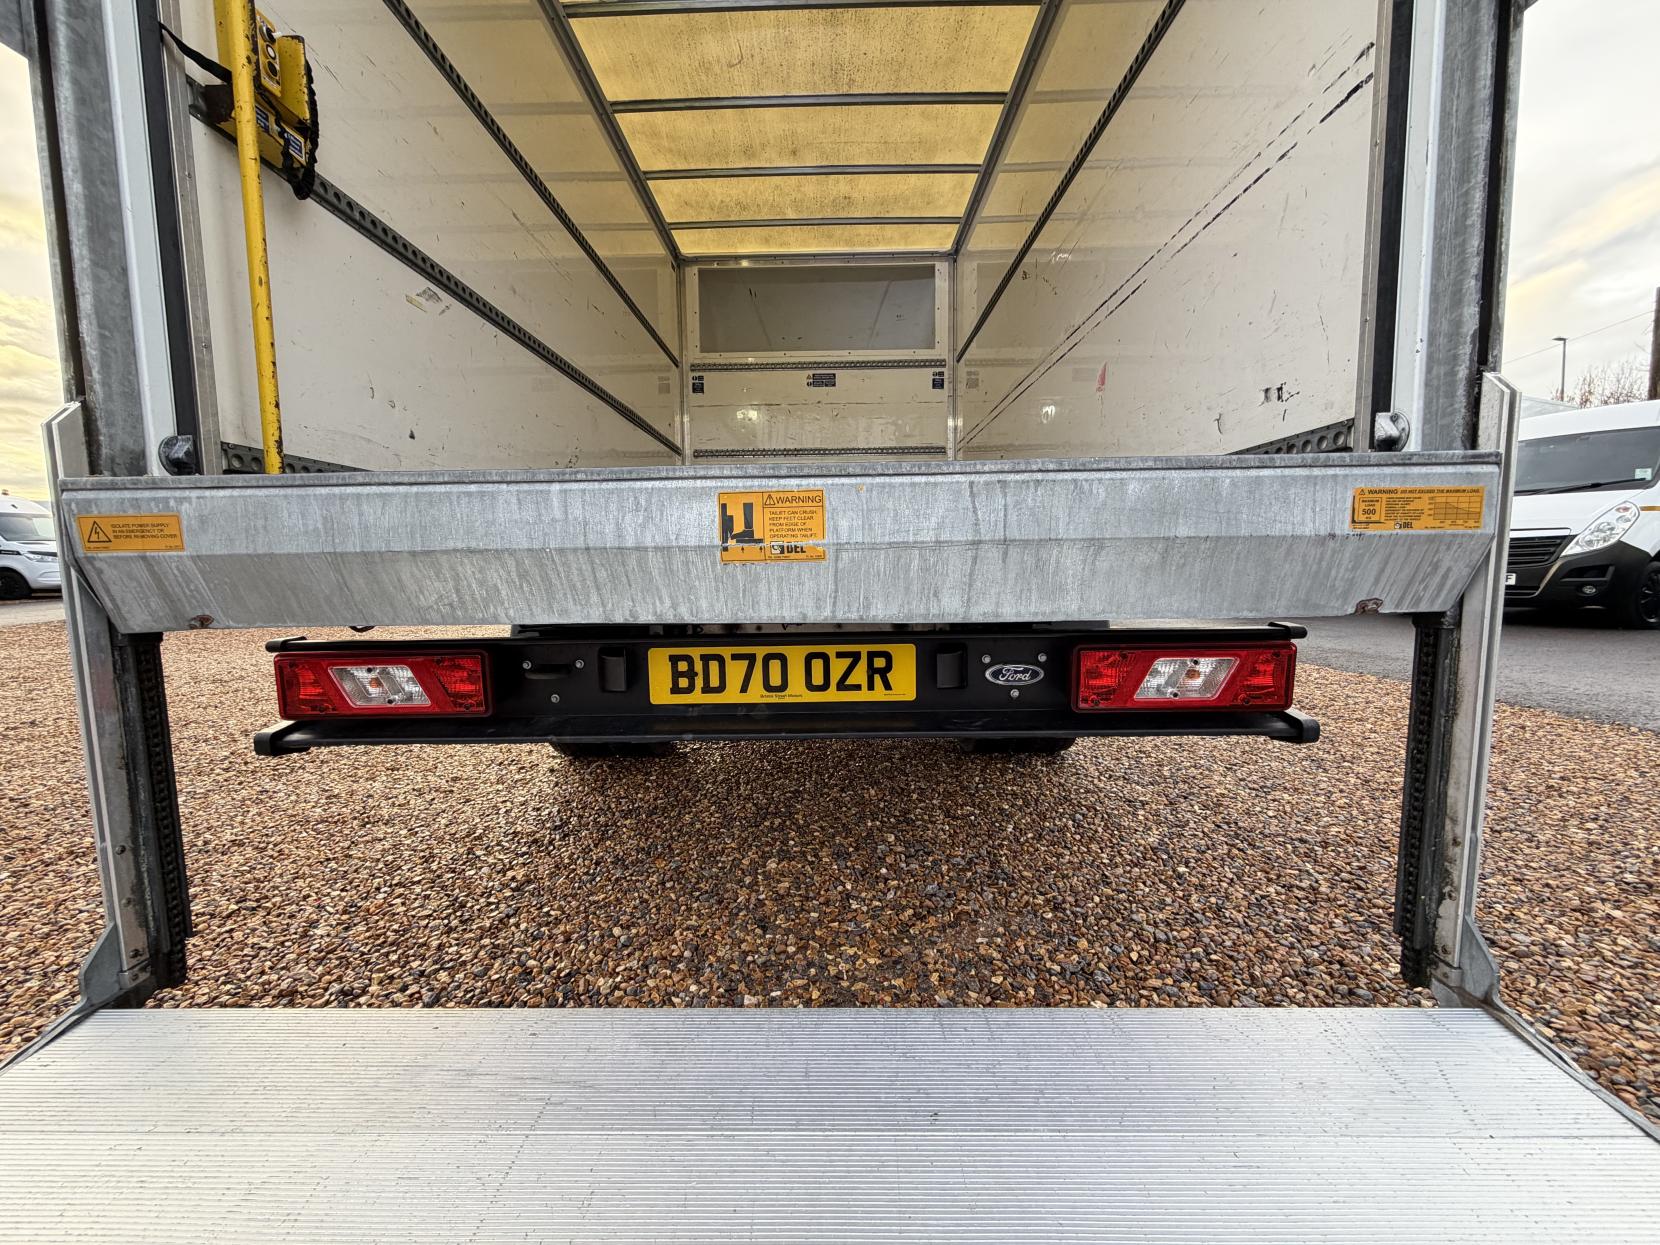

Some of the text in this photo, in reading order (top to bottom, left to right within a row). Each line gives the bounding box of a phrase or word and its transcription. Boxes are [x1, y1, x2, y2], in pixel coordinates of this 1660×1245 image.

[775, 495, 822, 505] WARNING
[1361, 508, 1377, 516] 500
[668, 650, 893, 695] BD70 OZR
[998, 667, 1032, 681] Ford
